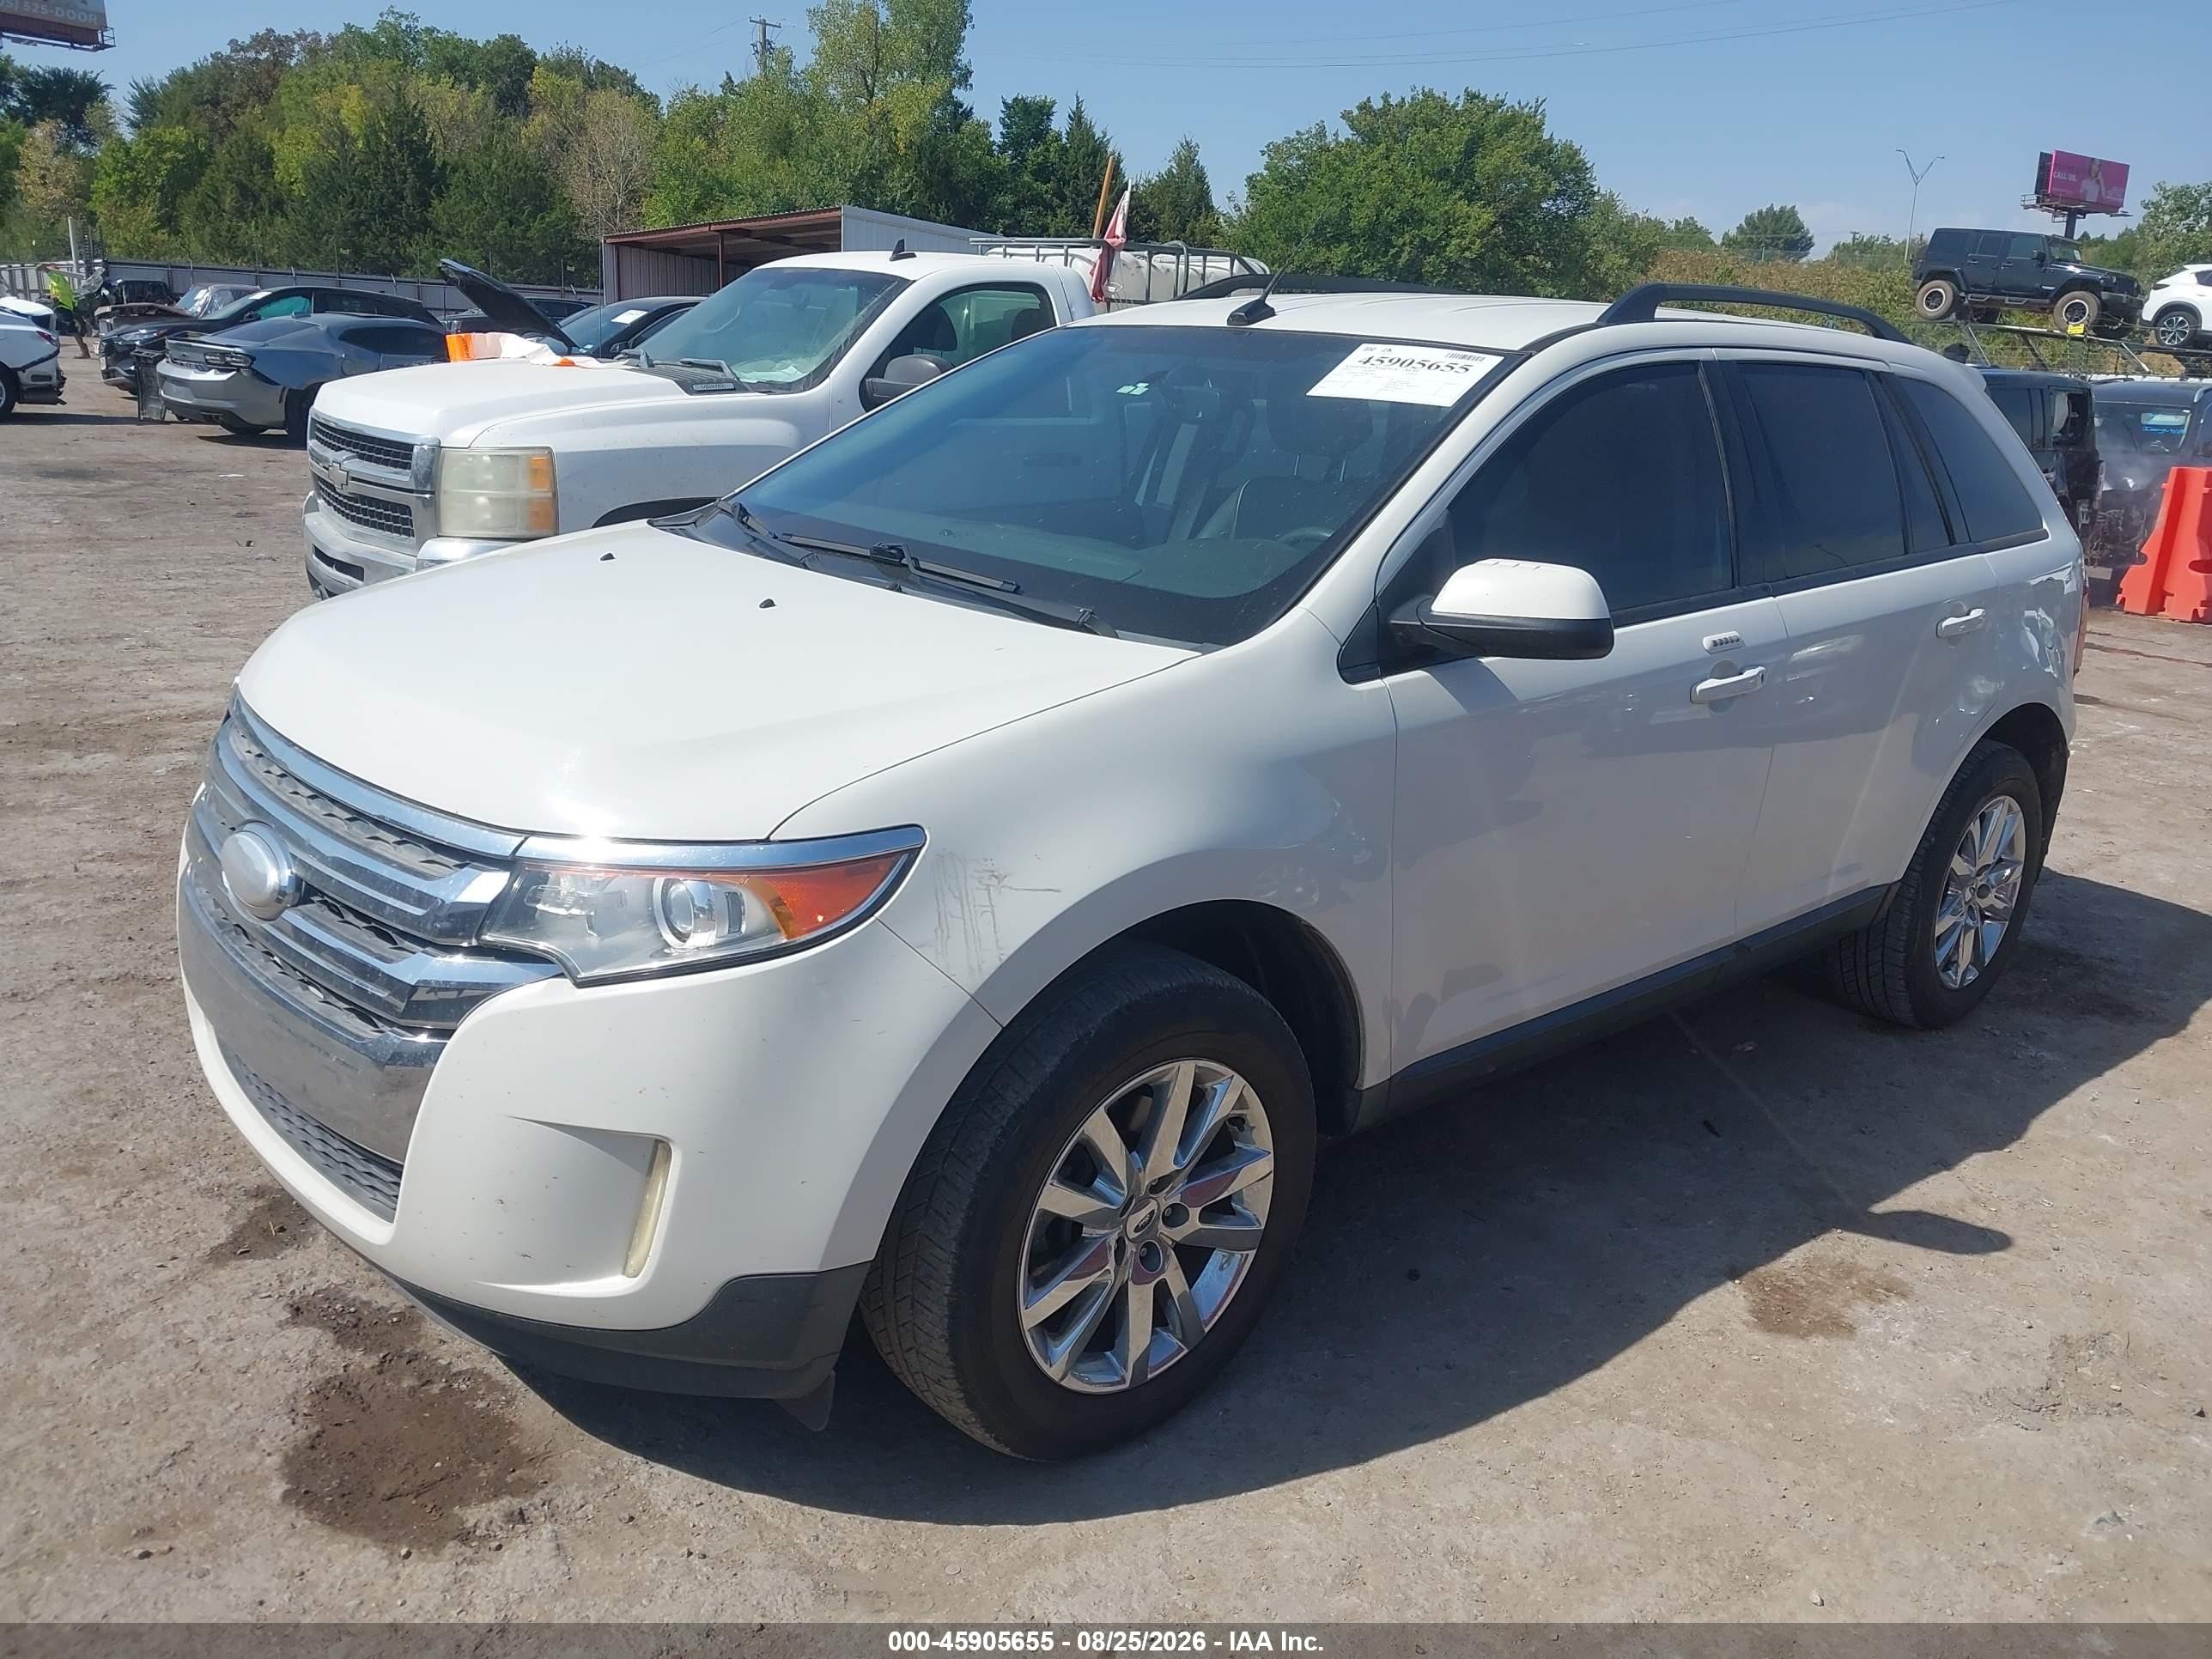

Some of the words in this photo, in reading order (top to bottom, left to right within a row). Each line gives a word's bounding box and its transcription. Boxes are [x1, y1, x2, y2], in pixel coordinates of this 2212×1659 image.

[22, 1, 97, 24] 525-DOOR
[2052, 171, 2067, 180] CALL
[1358, 356, 1474, 374] 45905655
